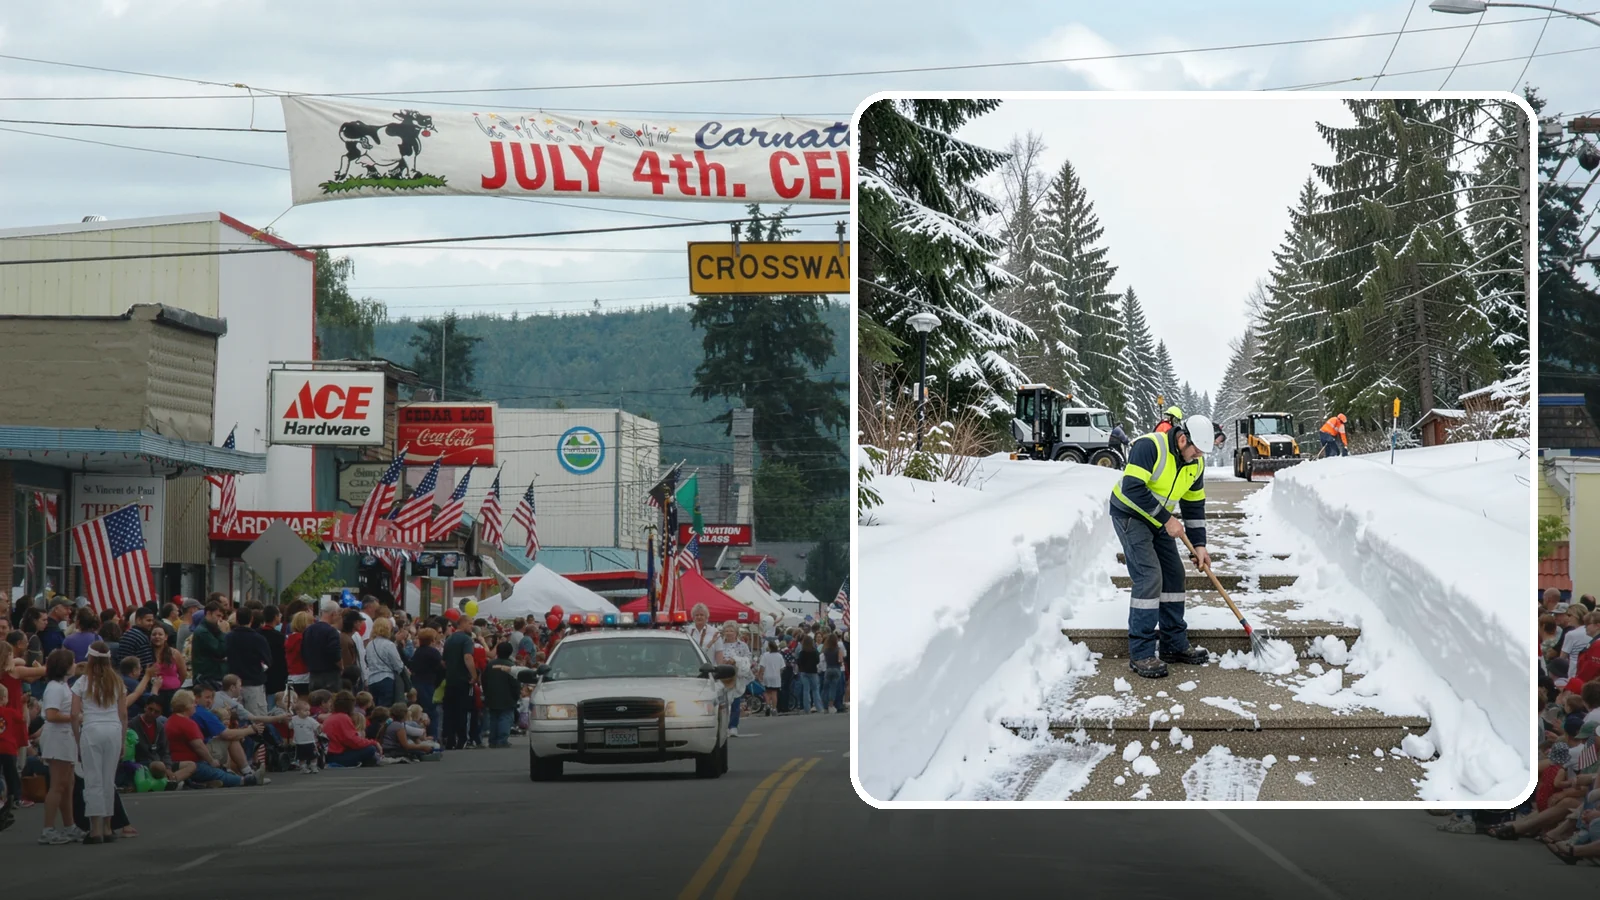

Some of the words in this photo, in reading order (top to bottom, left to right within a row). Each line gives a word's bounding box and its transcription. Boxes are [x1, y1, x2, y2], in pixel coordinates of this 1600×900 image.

[481, 141, 604, 192] JULY
[632, 150, 746, 197] 4th.
[697, 254, 850, 280] CROSSWA
[283, 380, 373, 420] ACE
[405, 409, 452, 422] CEDAR
[283, 421, 370, 436] Hardware
[416, 428, 476, 446] Coca-Cola
[354, 467, 384, 481] Simpl
[96, 485, 124, 495] Vincent
[126, 486, 136, 495] de
[137, 486, 155, 495] Paul
[688, 527, 742, 535] CRNATION
[699, 535, 730, 543] GLASS
